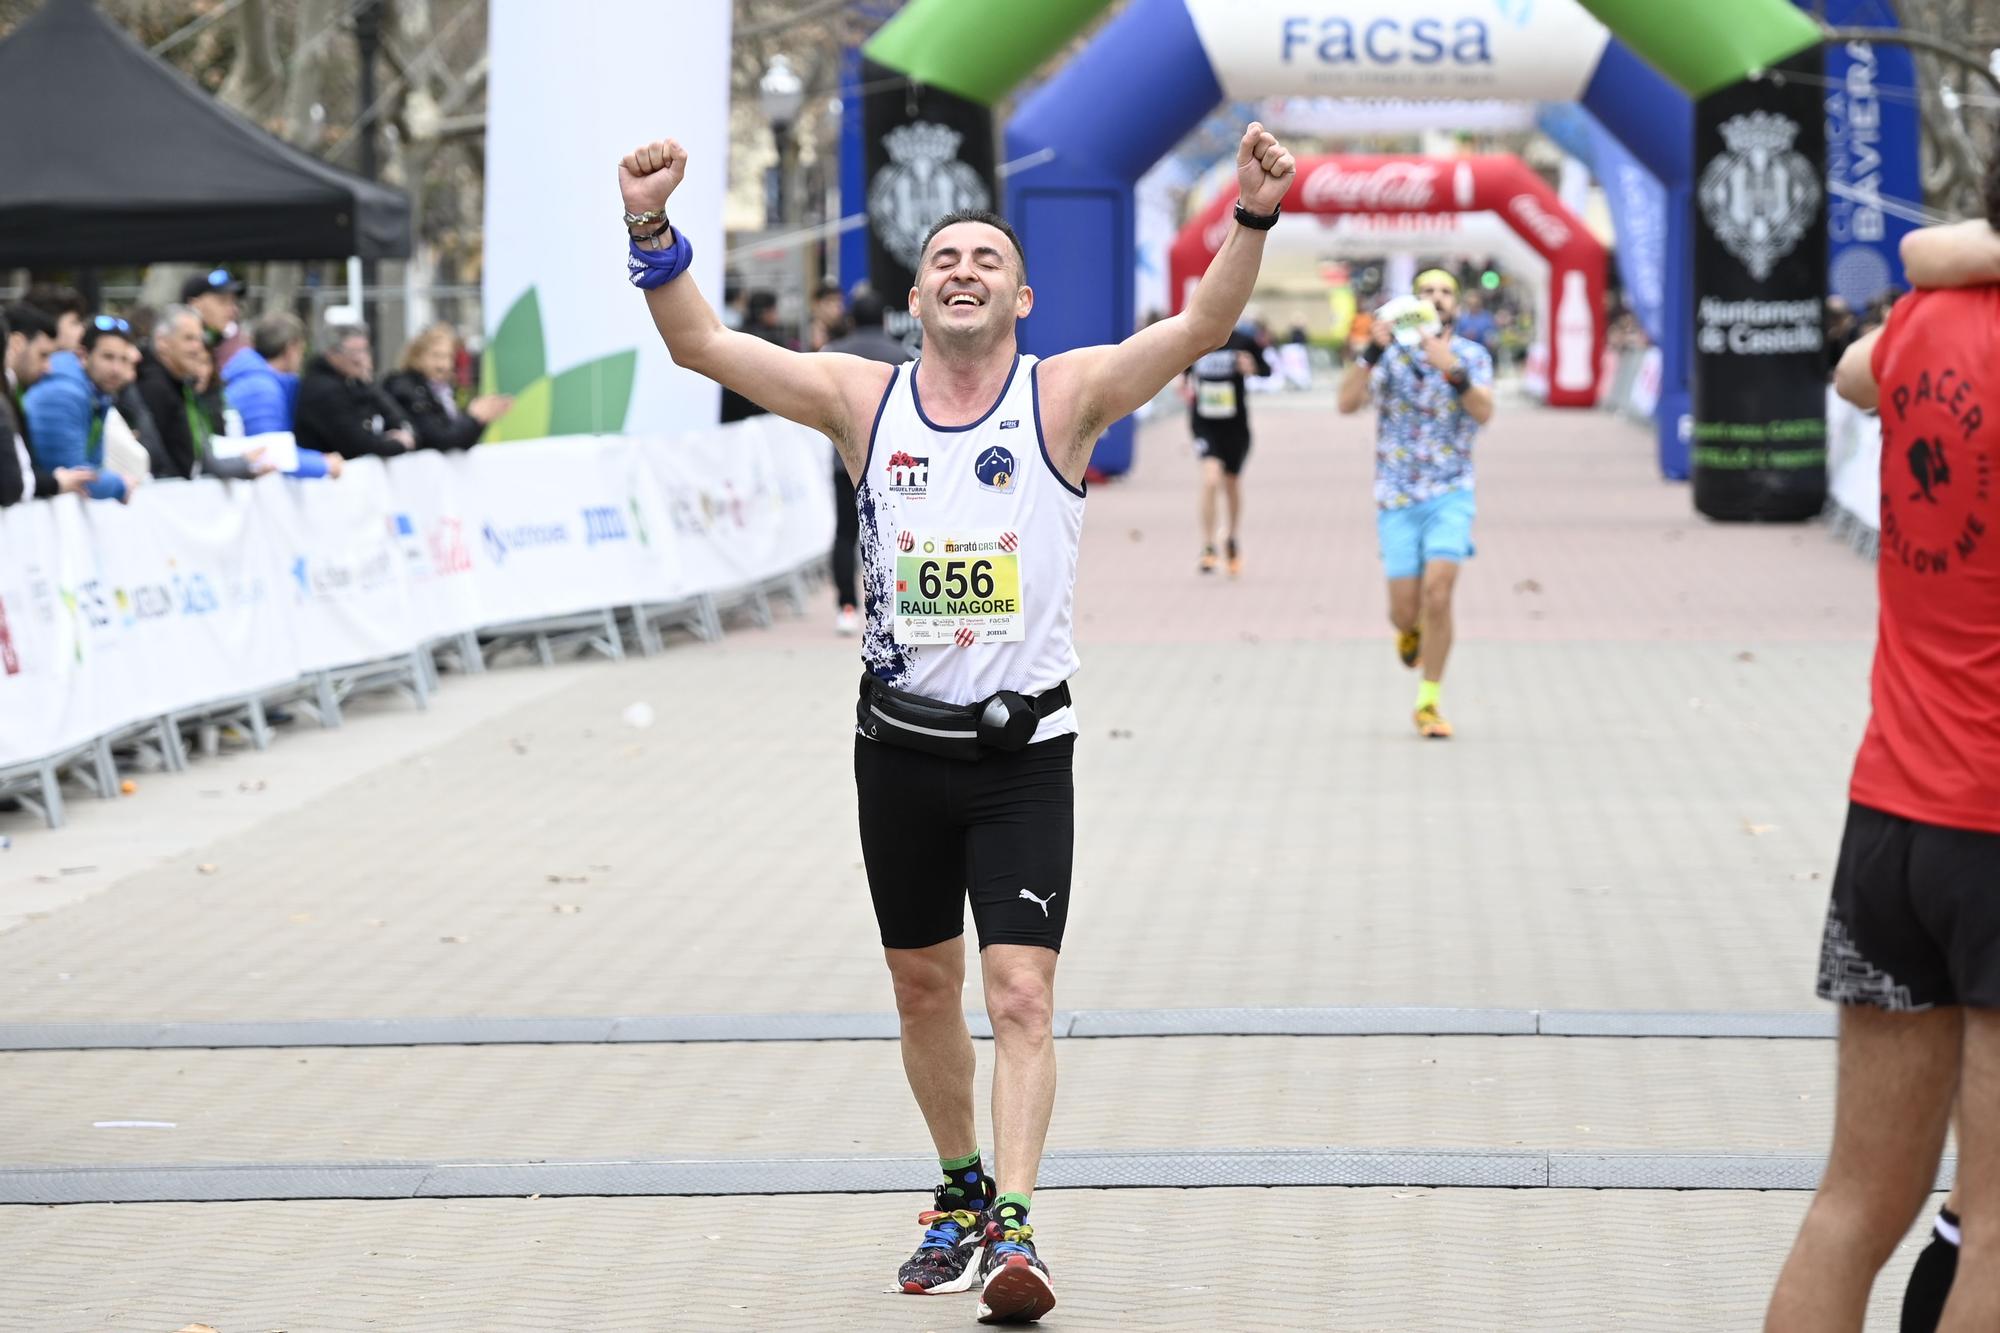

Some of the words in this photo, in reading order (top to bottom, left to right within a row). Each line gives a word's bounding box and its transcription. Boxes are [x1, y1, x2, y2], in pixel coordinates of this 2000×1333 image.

[1698, 297, 1821, 326] Ajuntament
[1698, 327, 1726, 354] de
[1891, 369, 1983, 441] PACER
[1955, 512, 1986, 560] ME
[919, 559, 994, 600] 656
[900, 600, 942, 615] RAUL
[947, 599, 1015, 614] NAGORE
